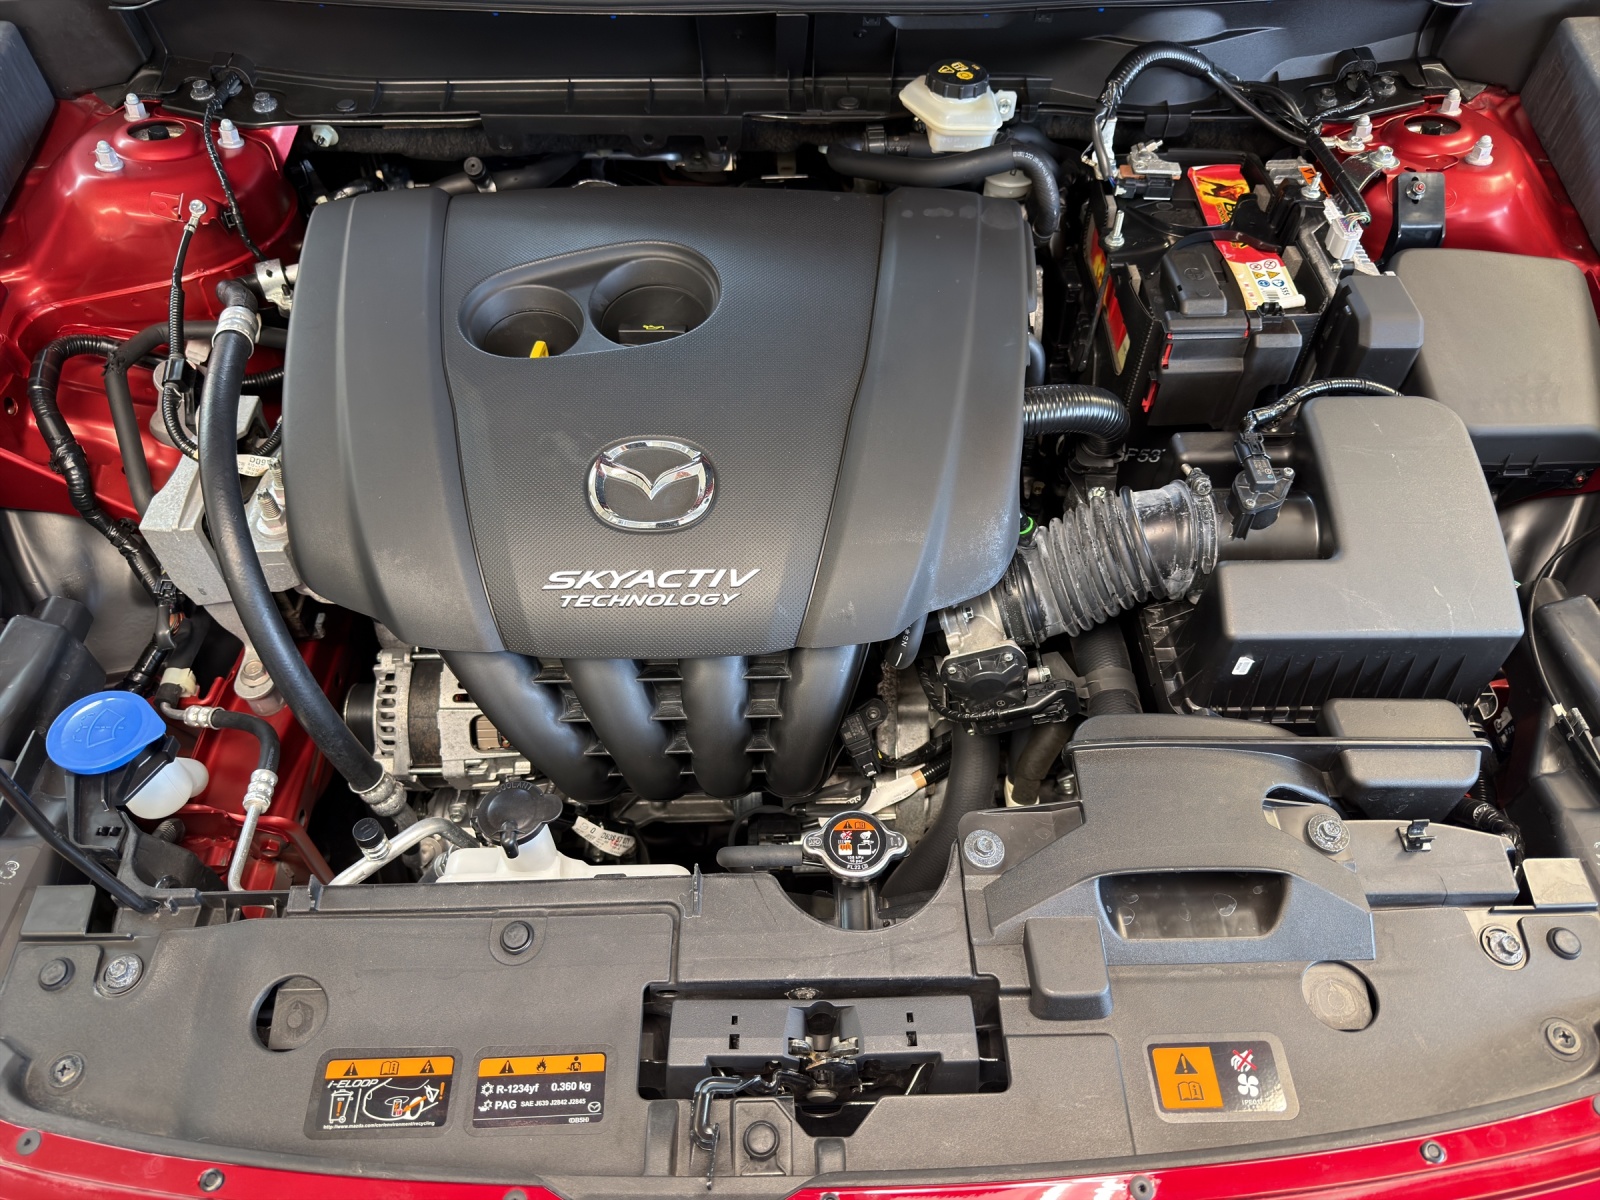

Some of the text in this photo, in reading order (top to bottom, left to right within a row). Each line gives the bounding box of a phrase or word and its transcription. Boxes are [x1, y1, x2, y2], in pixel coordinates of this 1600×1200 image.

[541, 568, 761, 590] SKYACTIV
[560, 593, 741, 608] TECHNOLOGY
[494, 781, 533, 793] COOLANT
[496, 1081, 592, 1095] R-1234yf 0.360 kg
[494, 1100, 517, 1110] PAG
